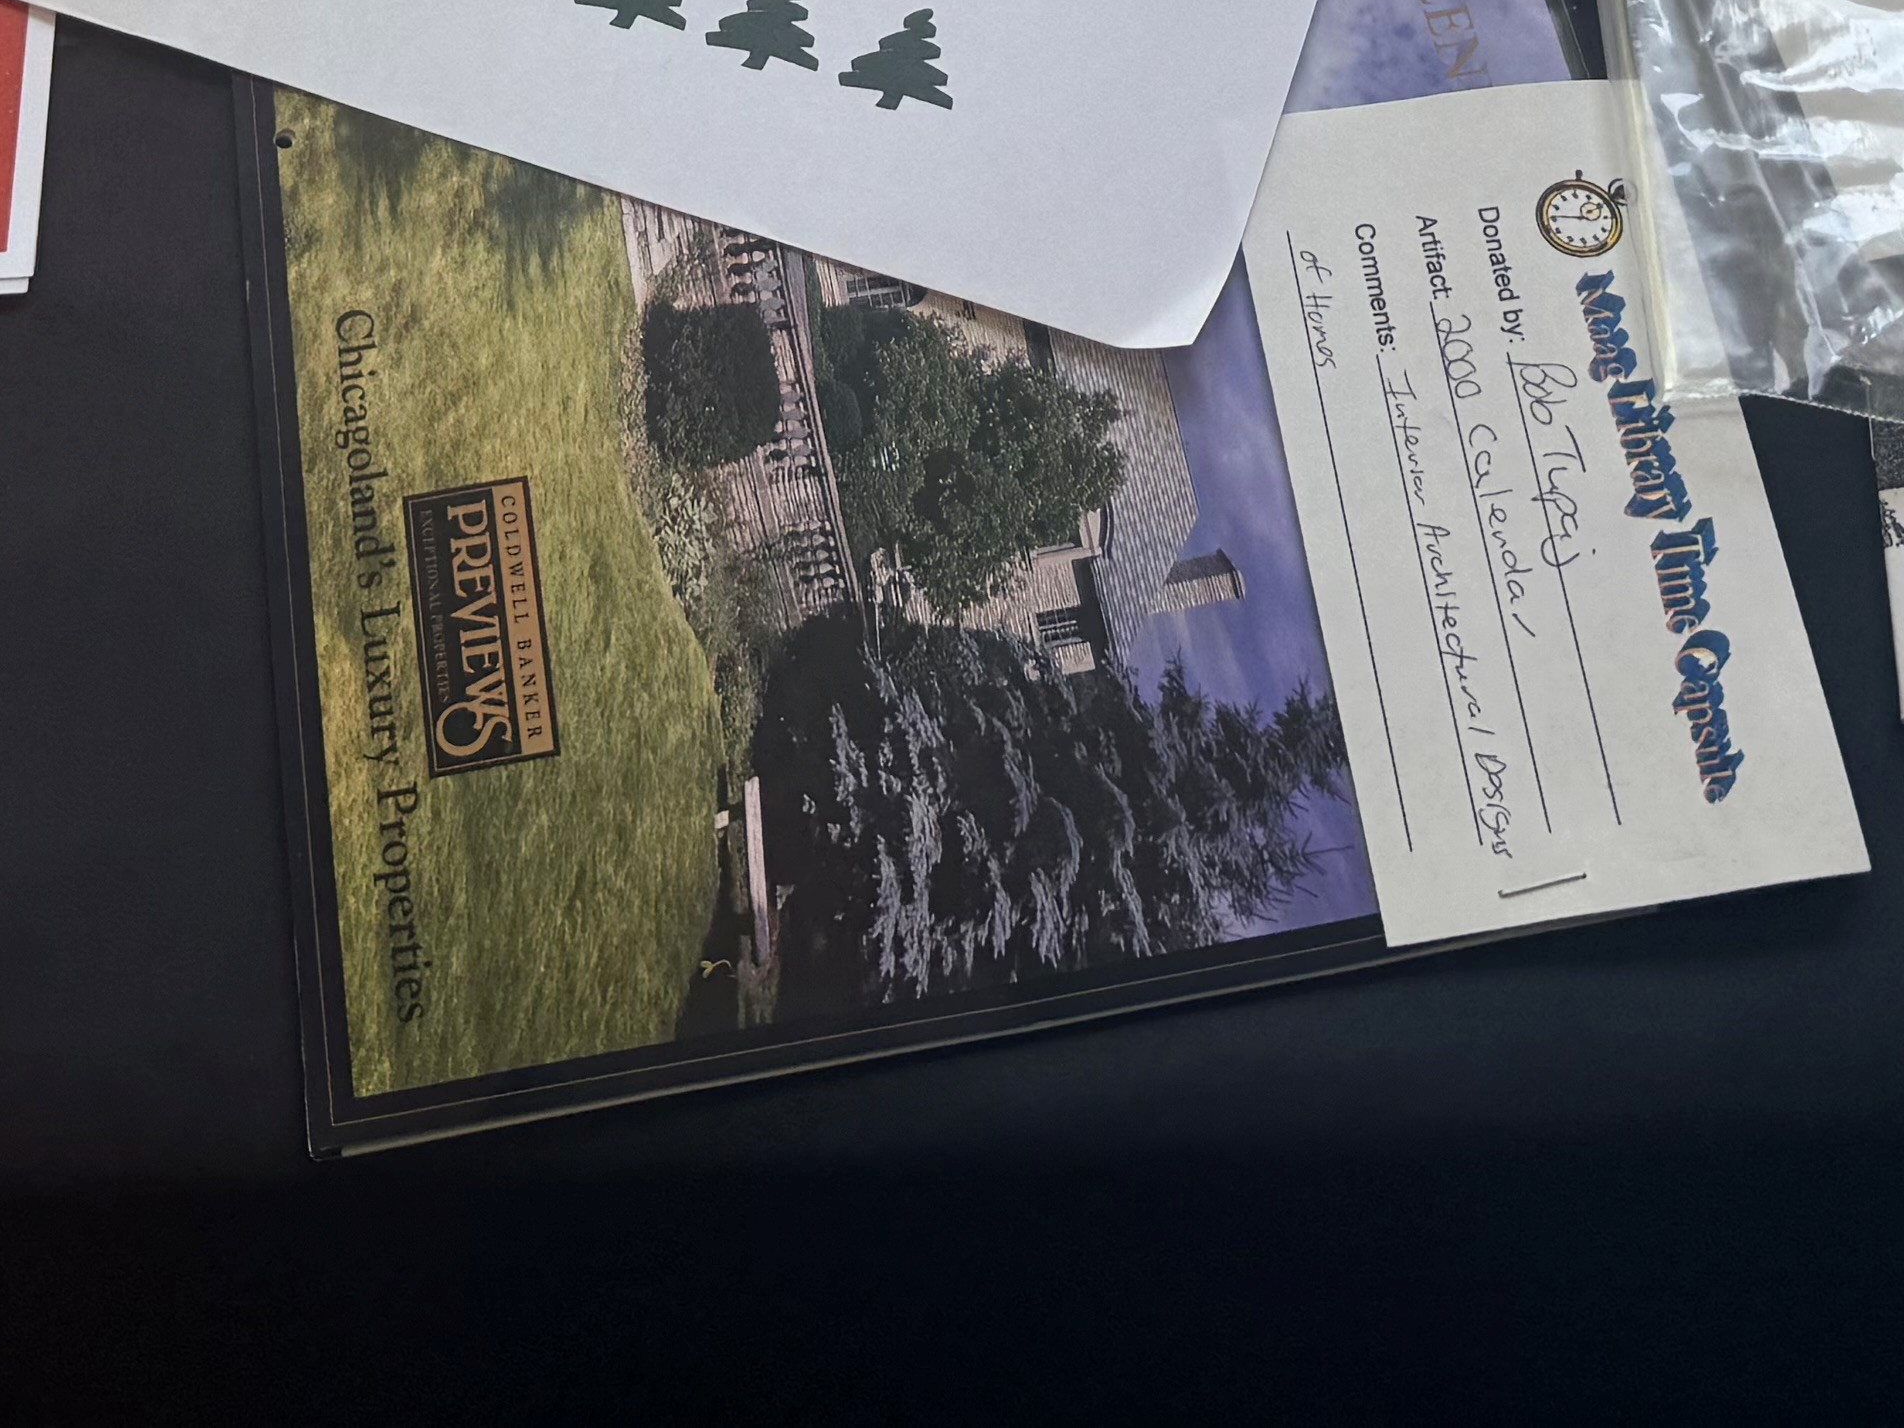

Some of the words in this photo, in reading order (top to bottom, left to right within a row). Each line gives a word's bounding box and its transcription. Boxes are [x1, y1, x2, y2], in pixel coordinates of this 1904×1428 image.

[1354, 223, 1395, 352] Comments:
[1415, 215, 1452, 303] Artifact:
[1477, 206, 1520, 301] Donated
[1502, 308, 1524, 343] by:
[334, 308, 390, 589] Chicagoland's
[1435, 313, 1472, 399] 2000
[1465, 423, 1537, 640] Calendar
[1514, 358, 1578, 425] Bob
[1605, 377, 1693, 524] Library
[435, 499, 513, 758] PREVIEWS
[500, 495, 528, 623] COLDWELL
[516, 638, 542, 739] BANKER
[1651, 516, 1716, 633] Time
[360, 605, 399, 776] Luxury
[1674, 629, 1745, 804] Capsule
[372, 786, 427, 1023] Properties
